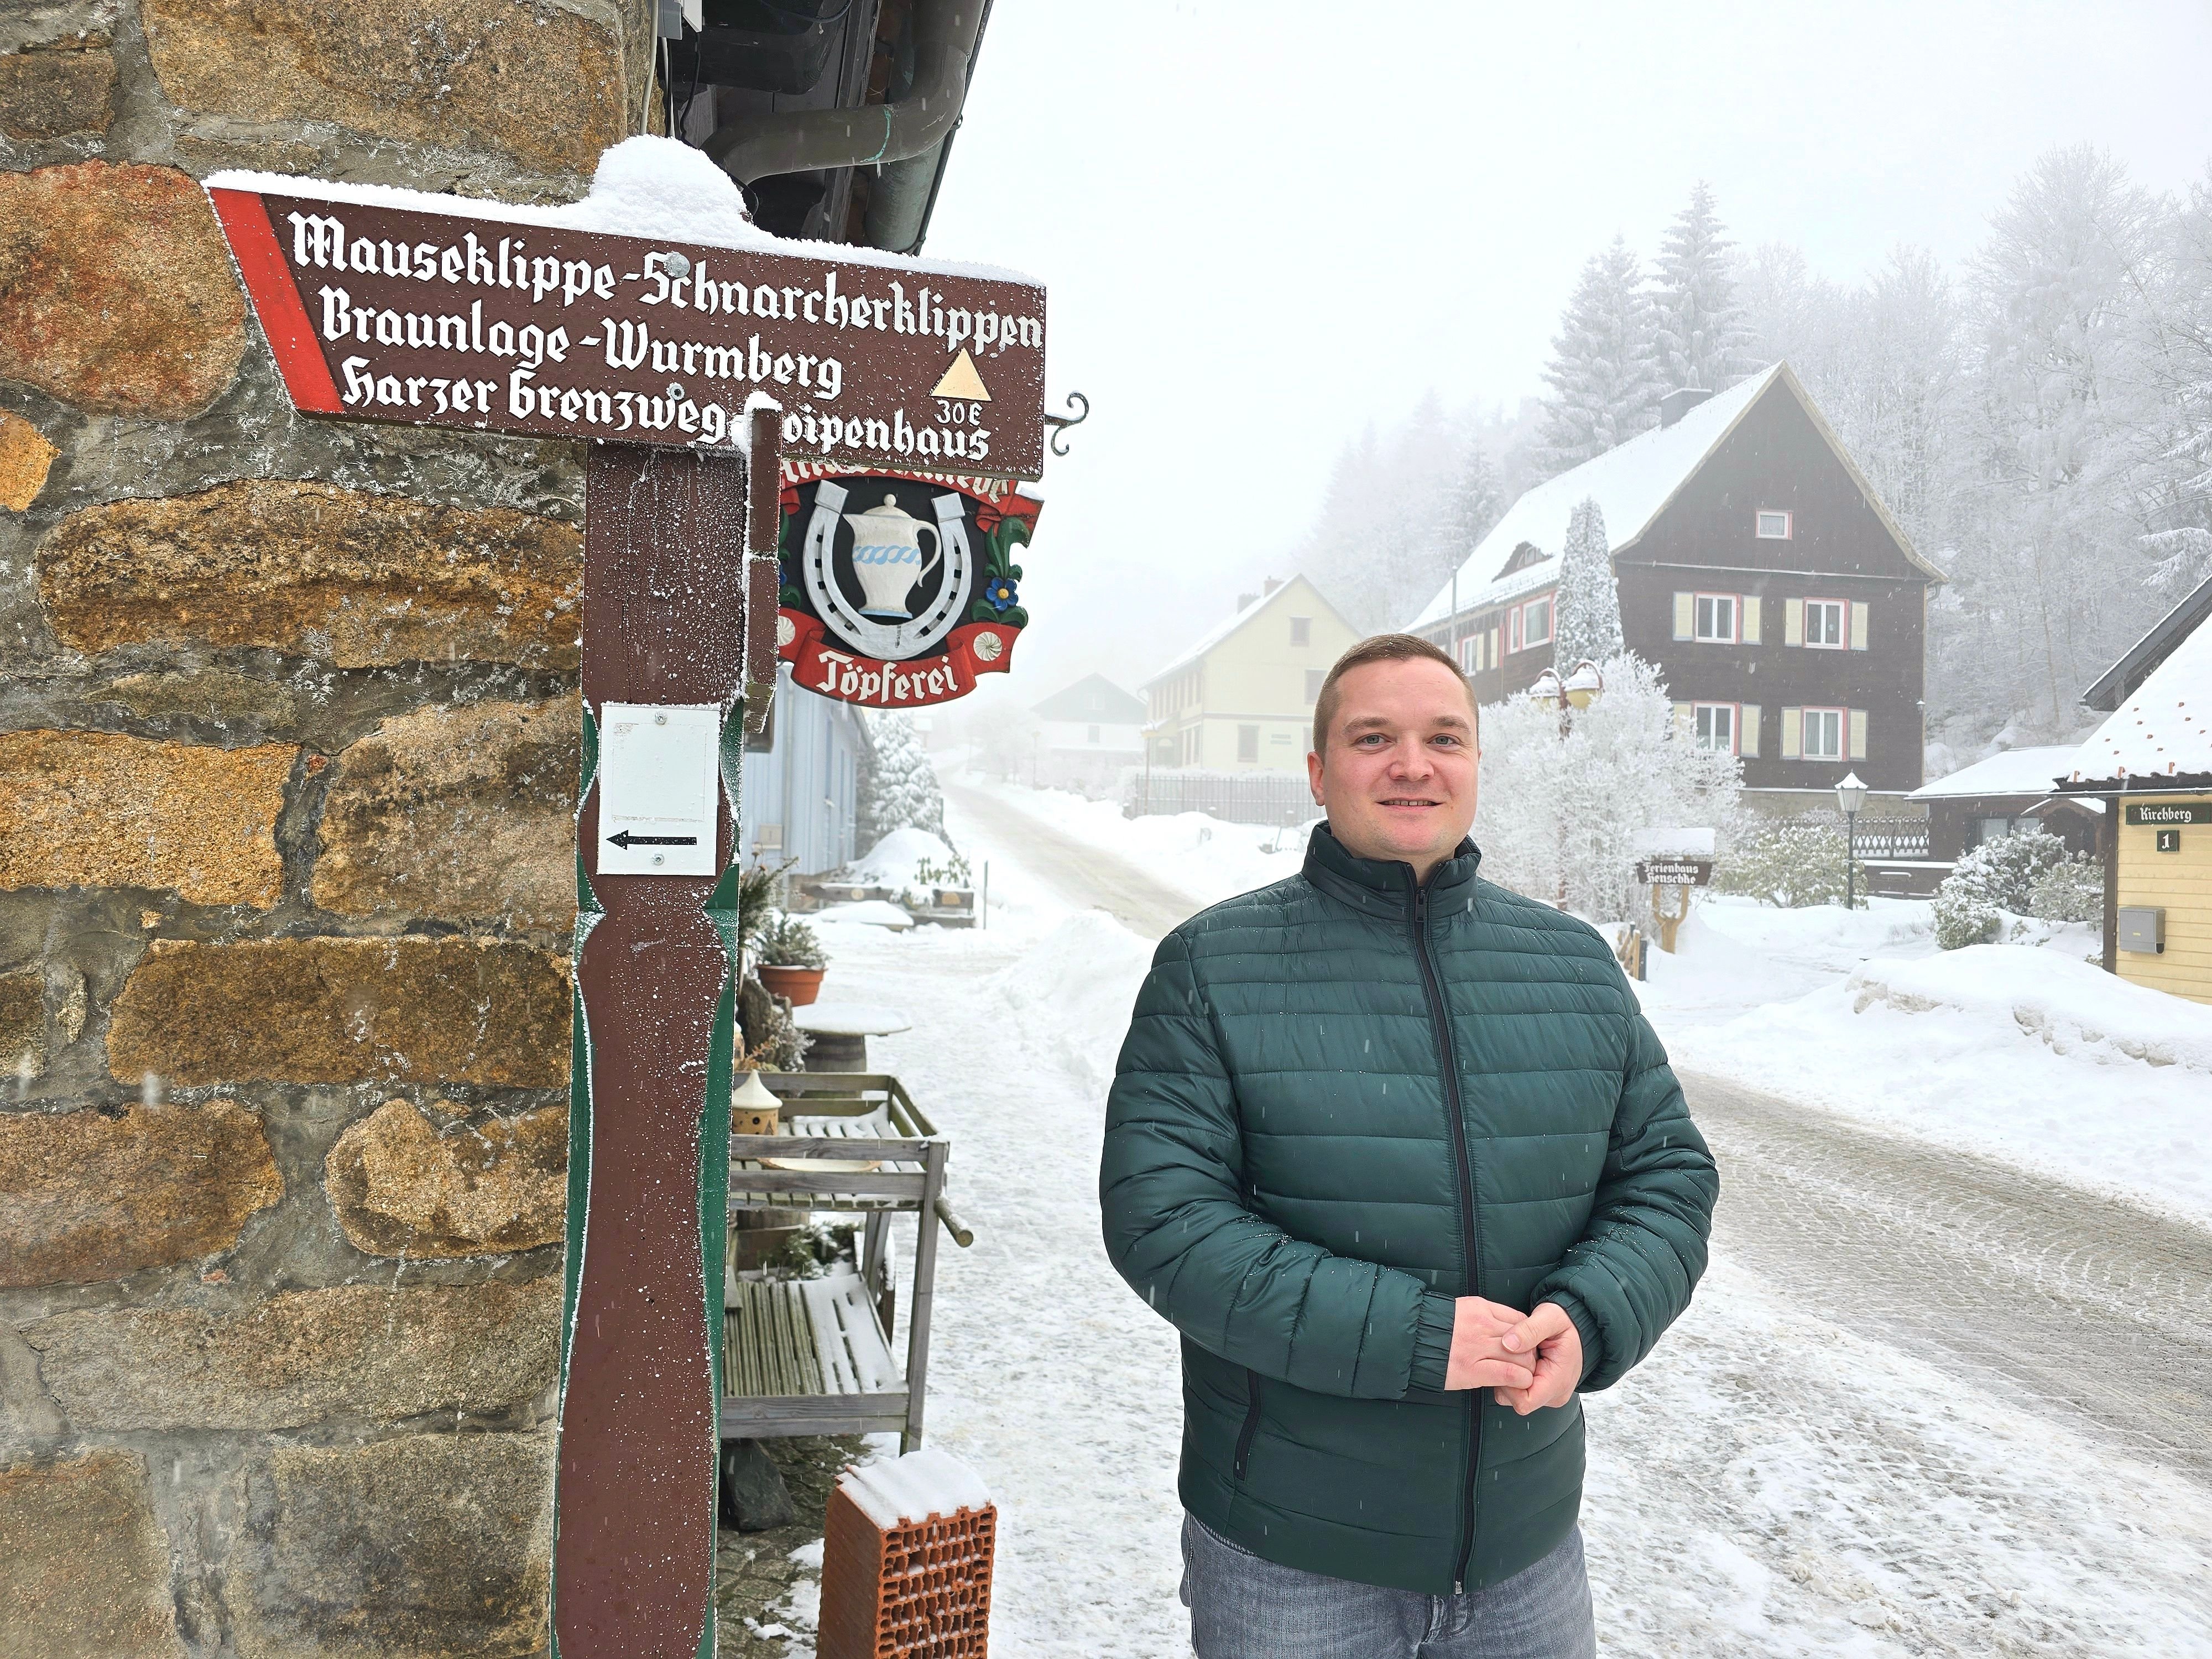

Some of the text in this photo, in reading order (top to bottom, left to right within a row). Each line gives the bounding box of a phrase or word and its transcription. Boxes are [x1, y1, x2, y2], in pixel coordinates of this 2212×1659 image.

[341, 355, 992, 462] Harzer Grenzweg oipenhaus
[816, 650, 958, 703] Töpferei
[2139, 806, 2192, 823] Kirchberg
[2162, 833, 2170, 849] 1
[1642, 862, 1699, 874] Ferienhaus
